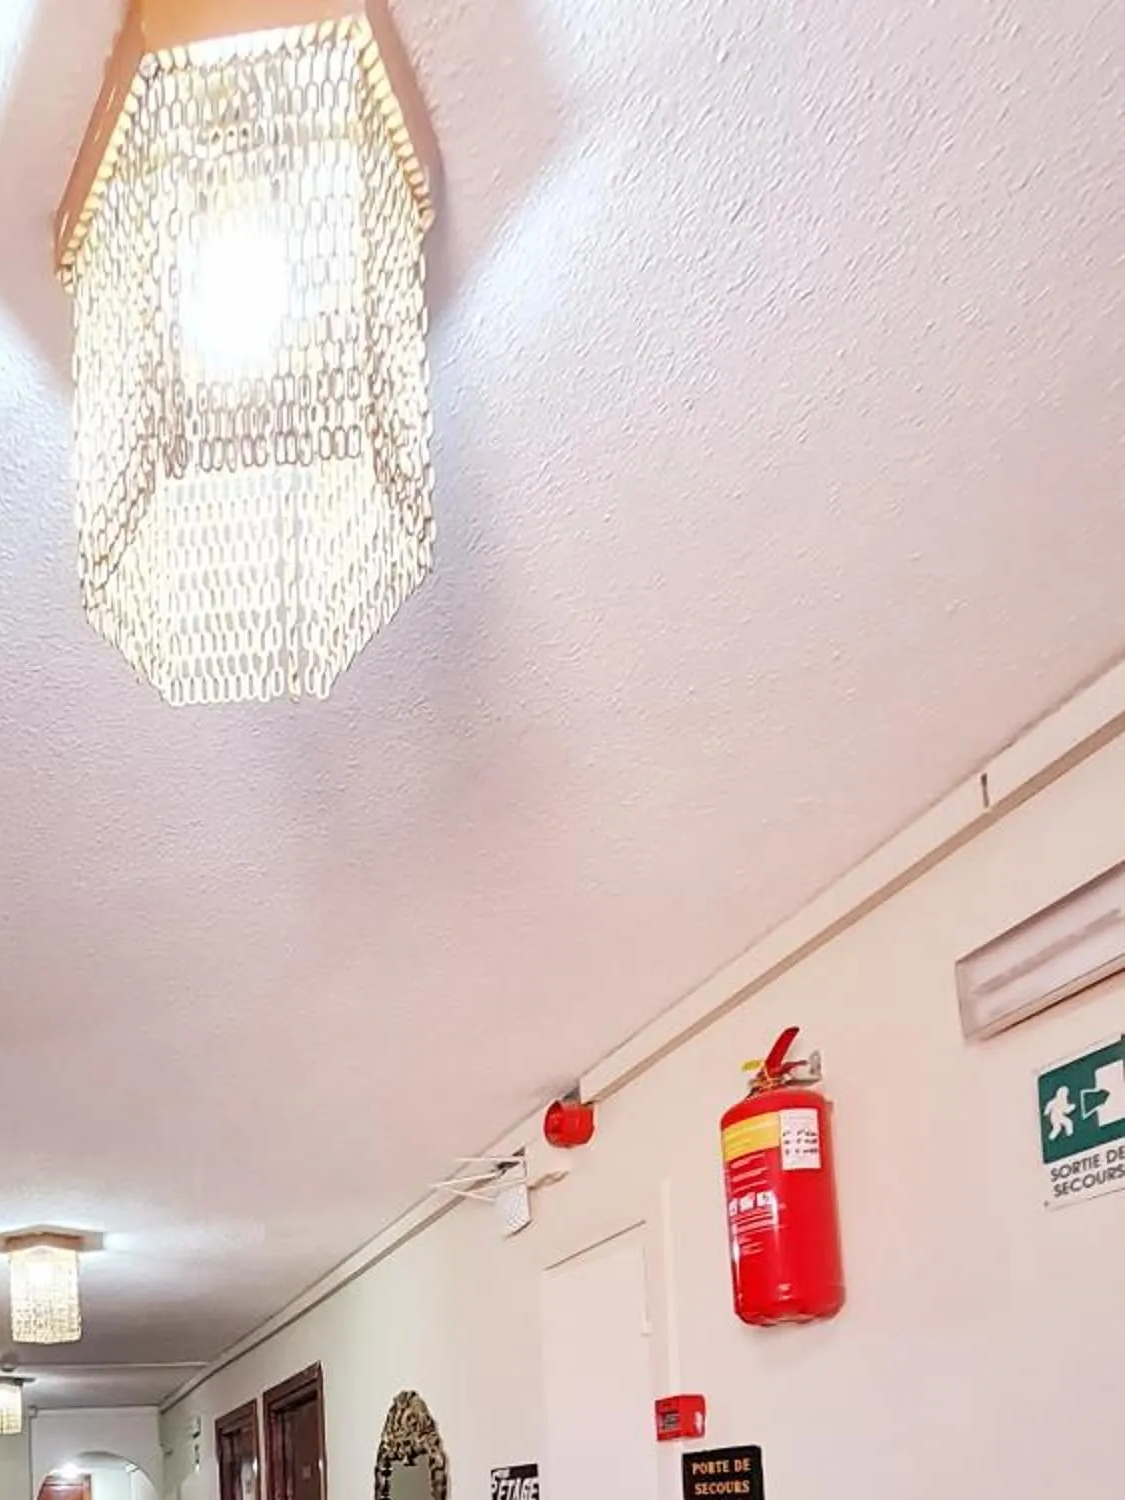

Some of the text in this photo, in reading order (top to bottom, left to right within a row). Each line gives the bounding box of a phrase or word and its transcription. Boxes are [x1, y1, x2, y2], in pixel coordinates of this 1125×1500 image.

[1050, 1145, 1125, 1182] SORTIE DE
[1053, 1164, 1125, 1198] SECOURS
[691, 1458, 752, 1475] PORTE DE
[694, 1480, 750, 1495] SECOURS
